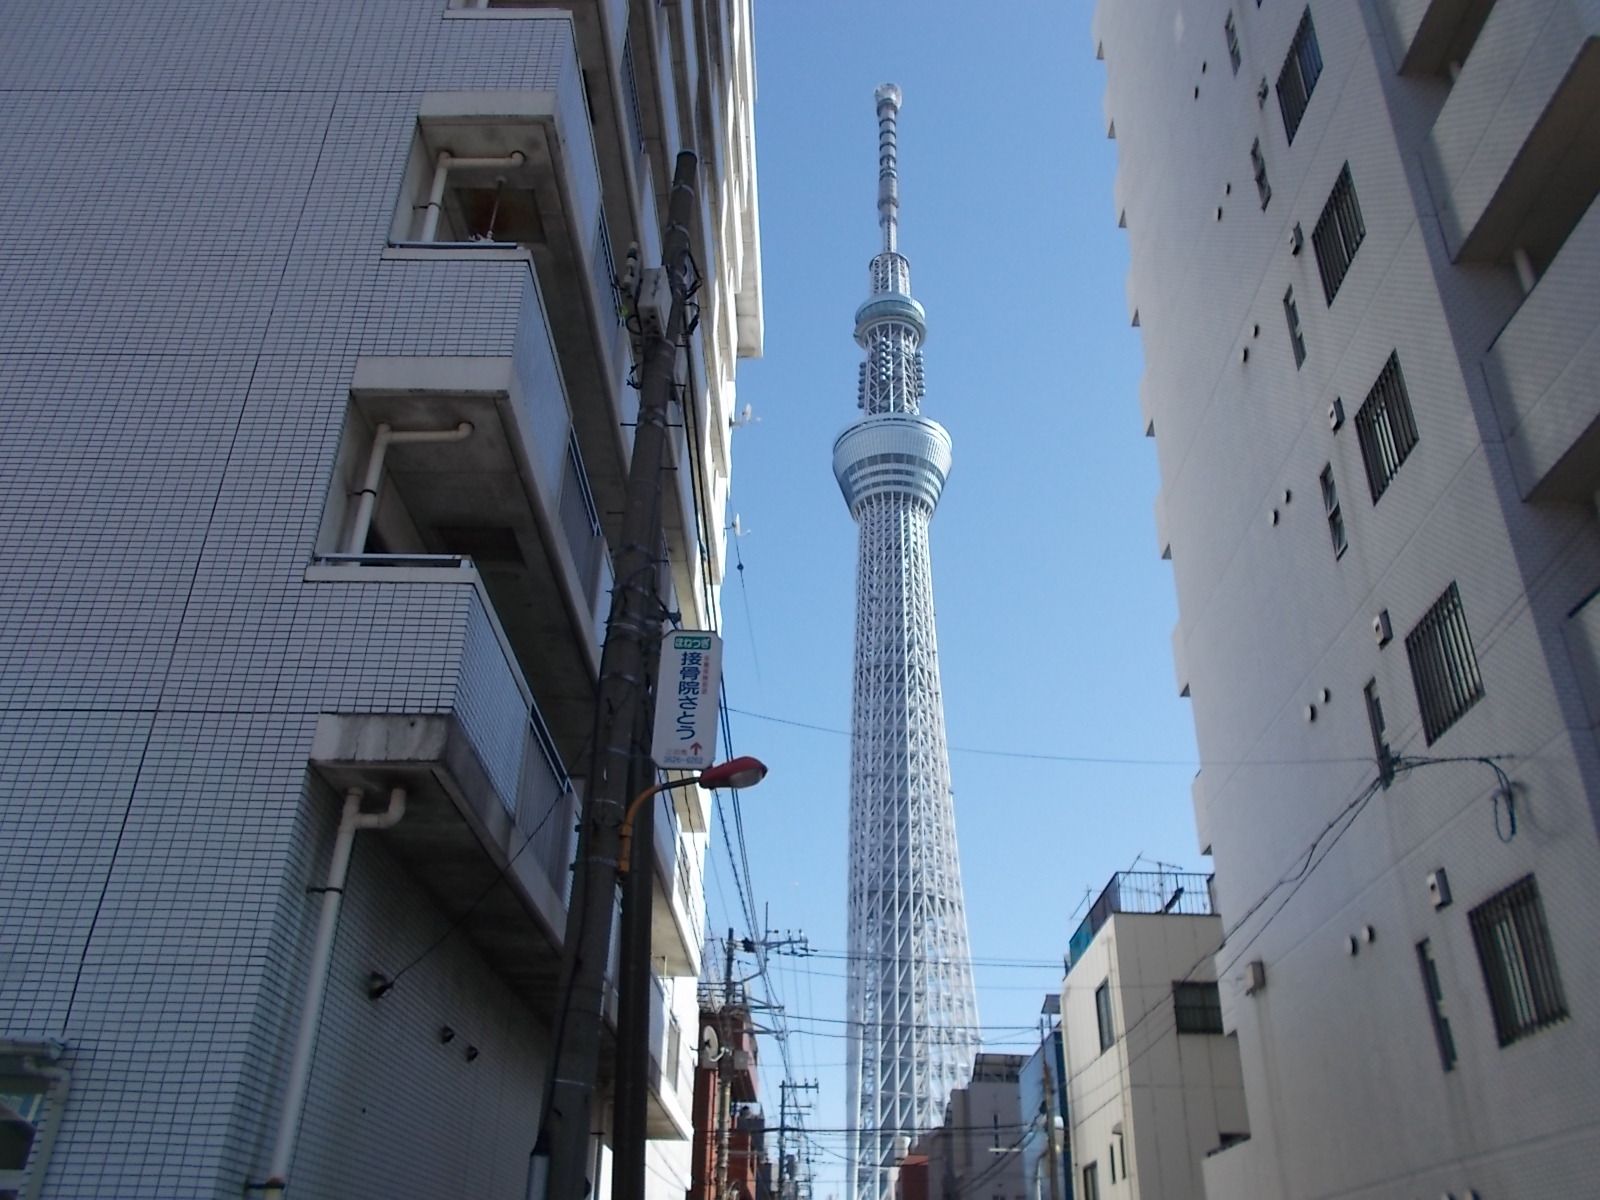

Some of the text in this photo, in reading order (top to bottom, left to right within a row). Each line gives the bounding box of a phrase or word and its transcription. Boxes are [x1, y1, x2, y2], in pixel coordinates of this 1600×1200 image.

[675, 637, 710, 649] ほねつぎ
[676, 652, 702, 740] 接骨院さとう
